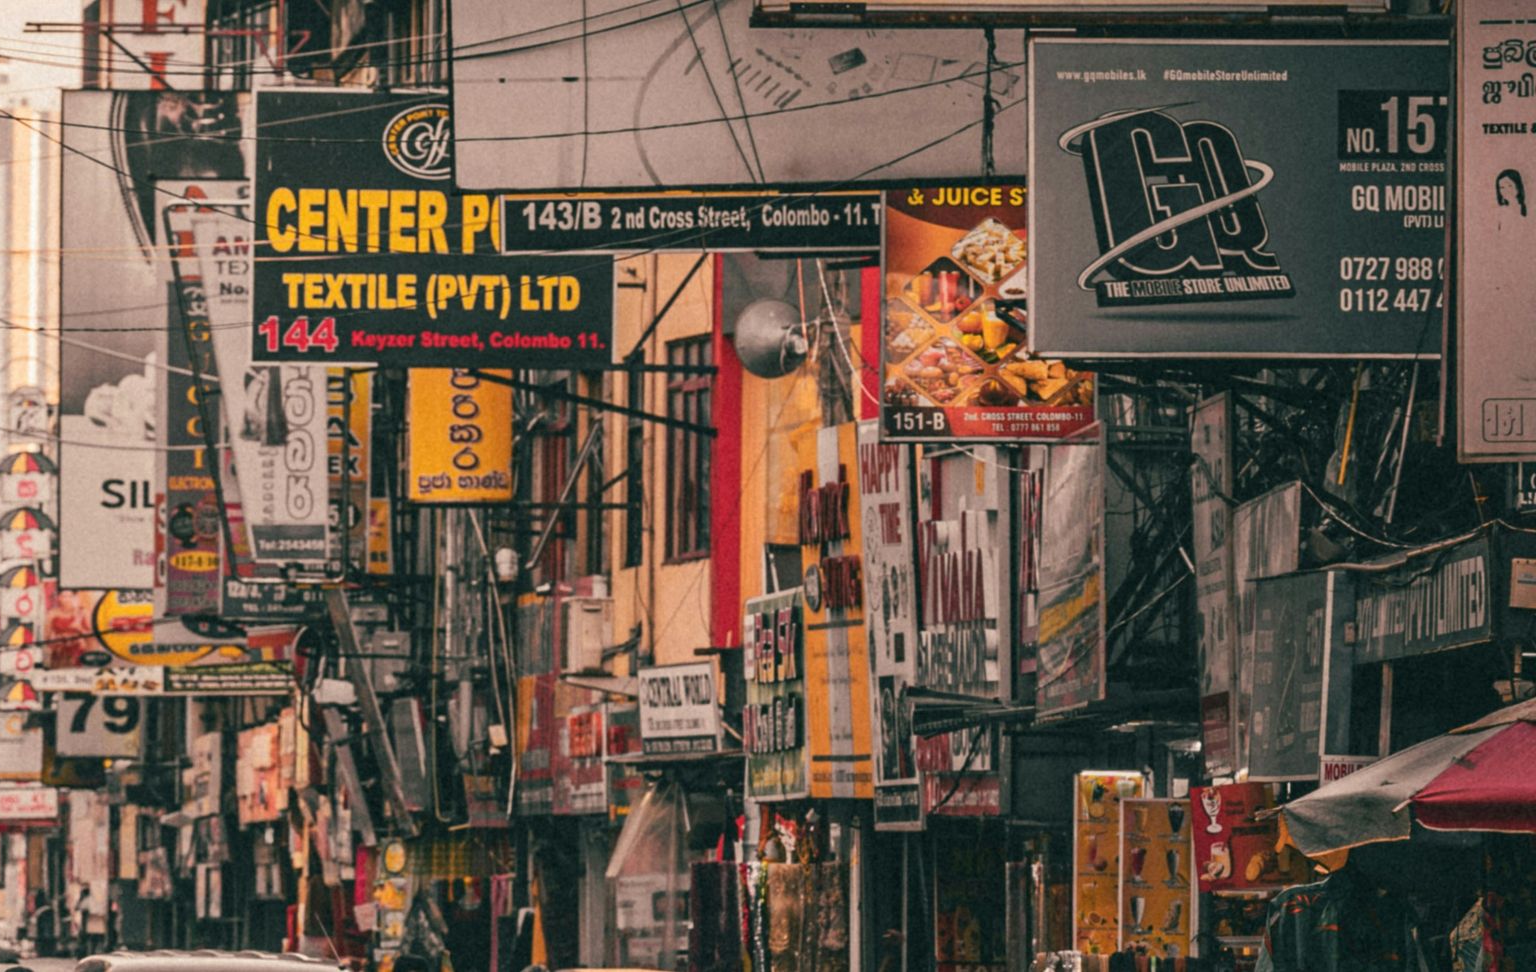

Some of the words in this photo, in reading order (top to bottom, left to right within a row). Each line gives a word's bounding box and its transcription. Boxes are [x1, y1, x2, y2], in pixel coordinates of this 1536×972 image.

[1056, 71, 1147, 83] www.gqmobiles.lk
[1163, 70, 1288, 82] #GQmobileStoreUnlimited
[1346, 128, 1381, 153] NO.
[1482, 123, 1527, 134] TEXTILE
[1339, 163, 1369, 172] MOBILE
[1401, 163, 1415, 172] 2ND
[1419, 163, 1445, 172] CROSS
[907, 188, 924, 205] &
[932, 187, 1003, 206] JUICE
[1009, 187, 1027, 206] S
[1082, 110, 1281, 276] GQ
[1351, 185, 1380, 213] GQ
[266, 187, 451, 254] CENTER
[522, 201, 602, 230] 143/B
[649, 206, 694, 228] Cross
[698, 205, 751, 232] Street,
[762, 203, 831, 227] Colombo
[1403, 214, 1432, 228] (PVT)
[1339, 257, 1391, 281] 0727
[1395, 257, 1433, 281] 988
[282, 273, 417, 309] TEXTILE
[426, 273, 511, 320] (PVT)
[520, 275, 581, 311] LTD
[1105, 281, 1130, 298] THE
[1131, 279, 1182, 298] MOBILE
[1183, 278, 1223, 295] STORE
[1224, 274, 1291, 293] UNLIMITED
[1339, 288, 1388, 312] 0112
[1393, 288, 1431, 312] 447
[258, 315, 339, 352] 144
[351, 330, 416, 352] Keyzer
[420, 331, 485, 351] Street,
[489, 332, 571, 349] Colombo
[577, 333, 606, 349] 11.
[893, 412, 945, 431] 151-B
[981, 412, 1005, 421] CROSS
[991, 423, 1005, 432] TEL
[1011, 423, 1030, 432] 0777
[860, 443, 901, 495] HAPPY
[66, 694, 141, 734] 79
